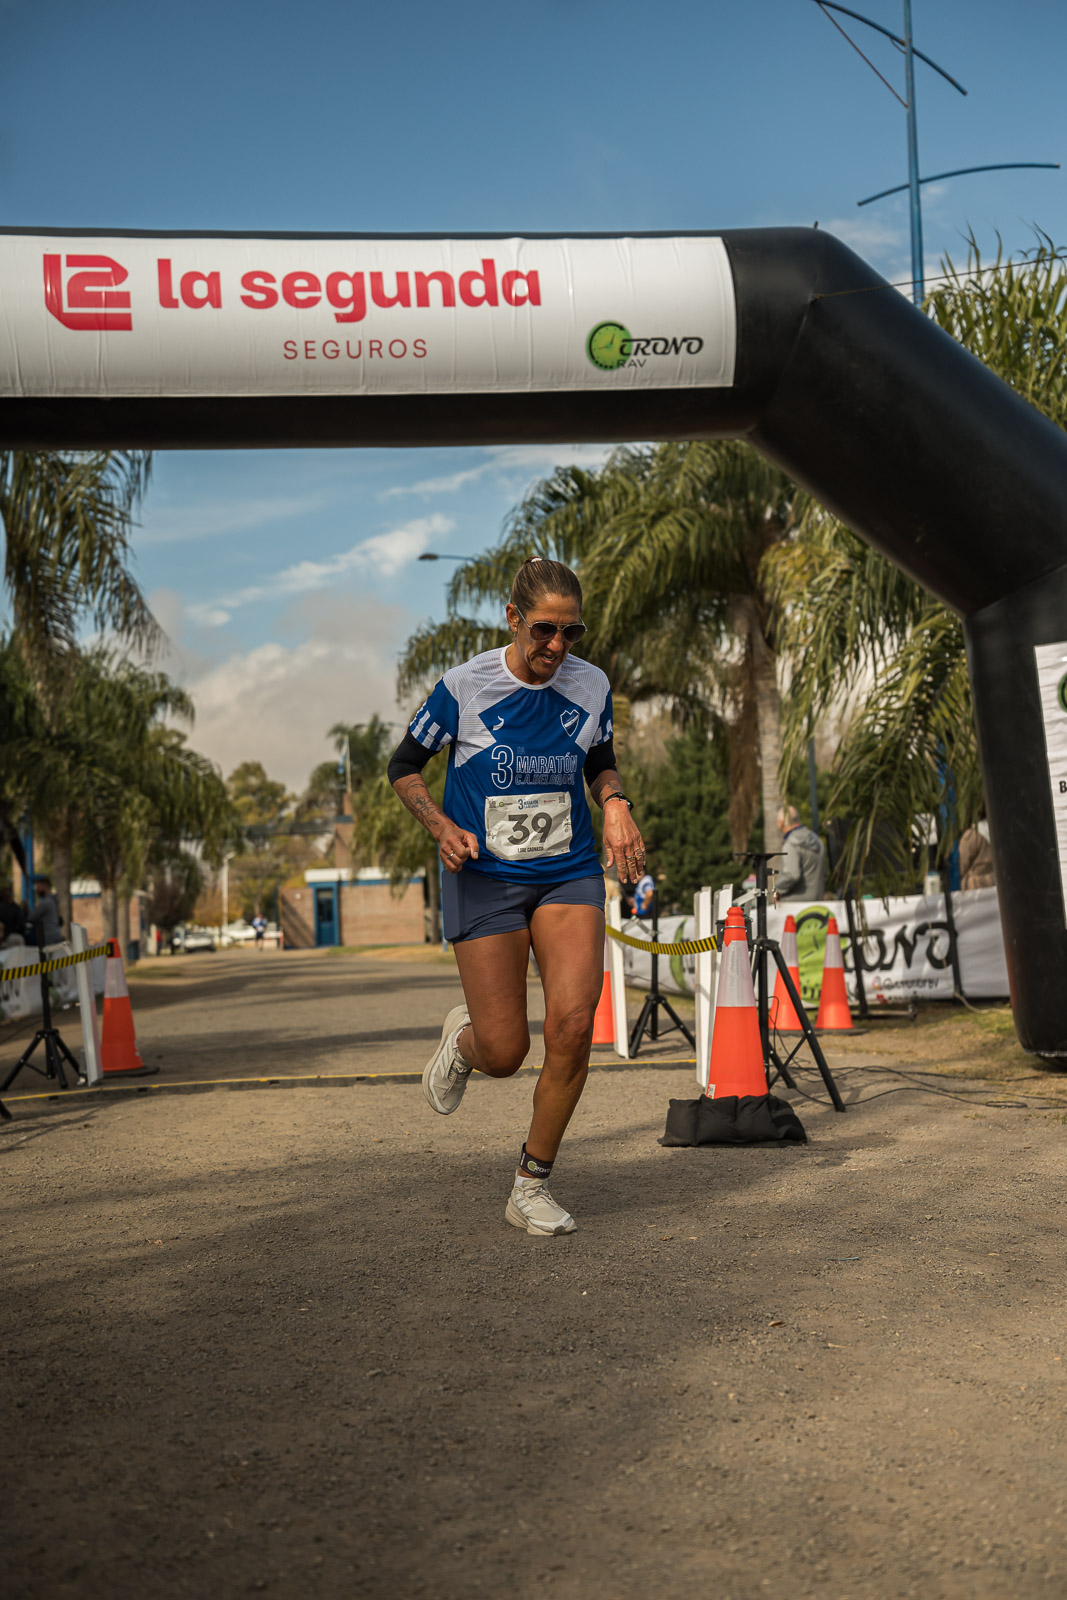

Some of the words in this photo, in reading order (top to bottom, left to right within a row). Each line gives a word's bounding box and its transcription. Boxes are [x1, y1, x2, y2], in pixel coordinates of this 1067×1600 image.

[157, 258, 222, 309] la
[239, 258, 542, 323] segunda
[283, 338, 427, 360] SEGUROS
[619, 336, 704, 356] CRONO
[616, 359, 647, 368] RAV
[491, 744, 514, 790] 3
[516, 753, 578, 773] MARATÓN
[518, 798, 524, 810] 3
[507, 812, 553, 845] 39
